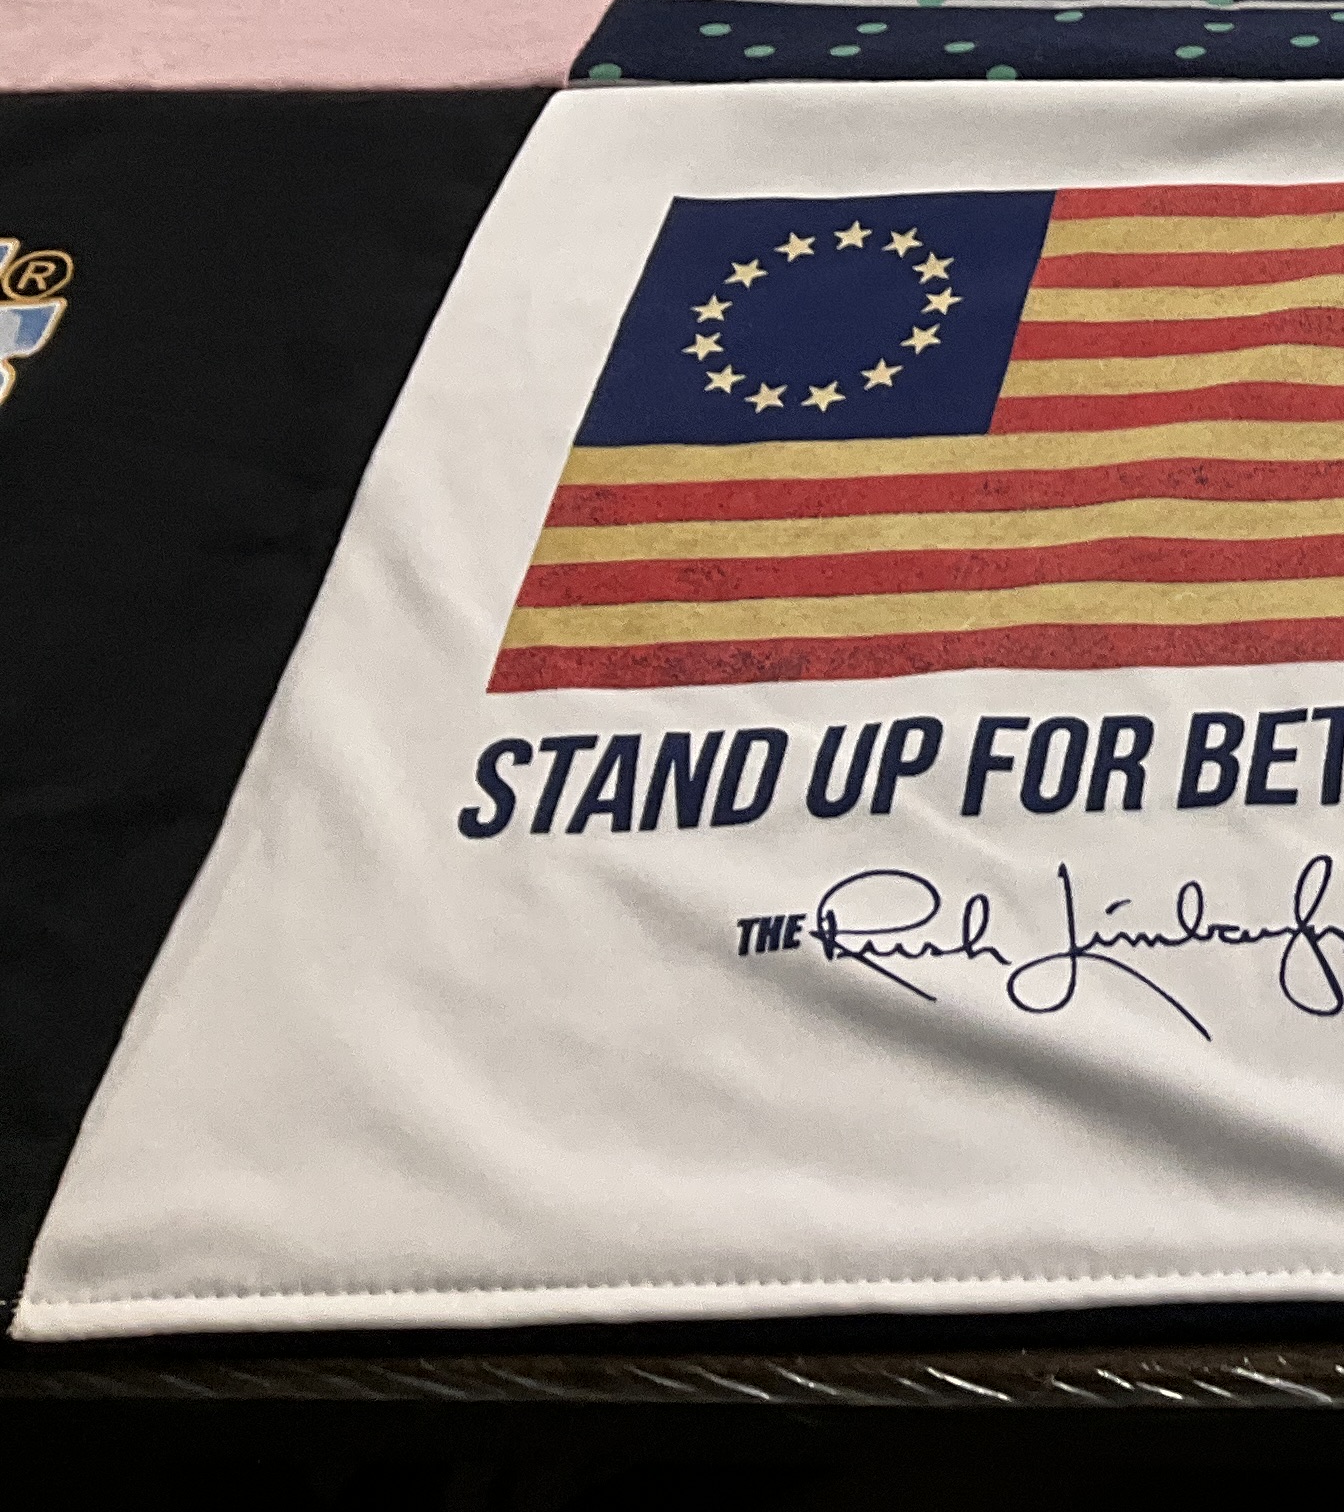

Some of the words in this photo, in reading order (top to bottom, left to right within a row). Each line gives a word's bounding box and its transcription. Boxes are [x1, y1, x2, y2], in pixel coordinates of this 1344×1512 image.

[457, 725, 790, 840] STAND
[804, 715, 944, 819] UP
[960, 714, 1155, 817] FOR
[737, 913, 808, 957] THE
